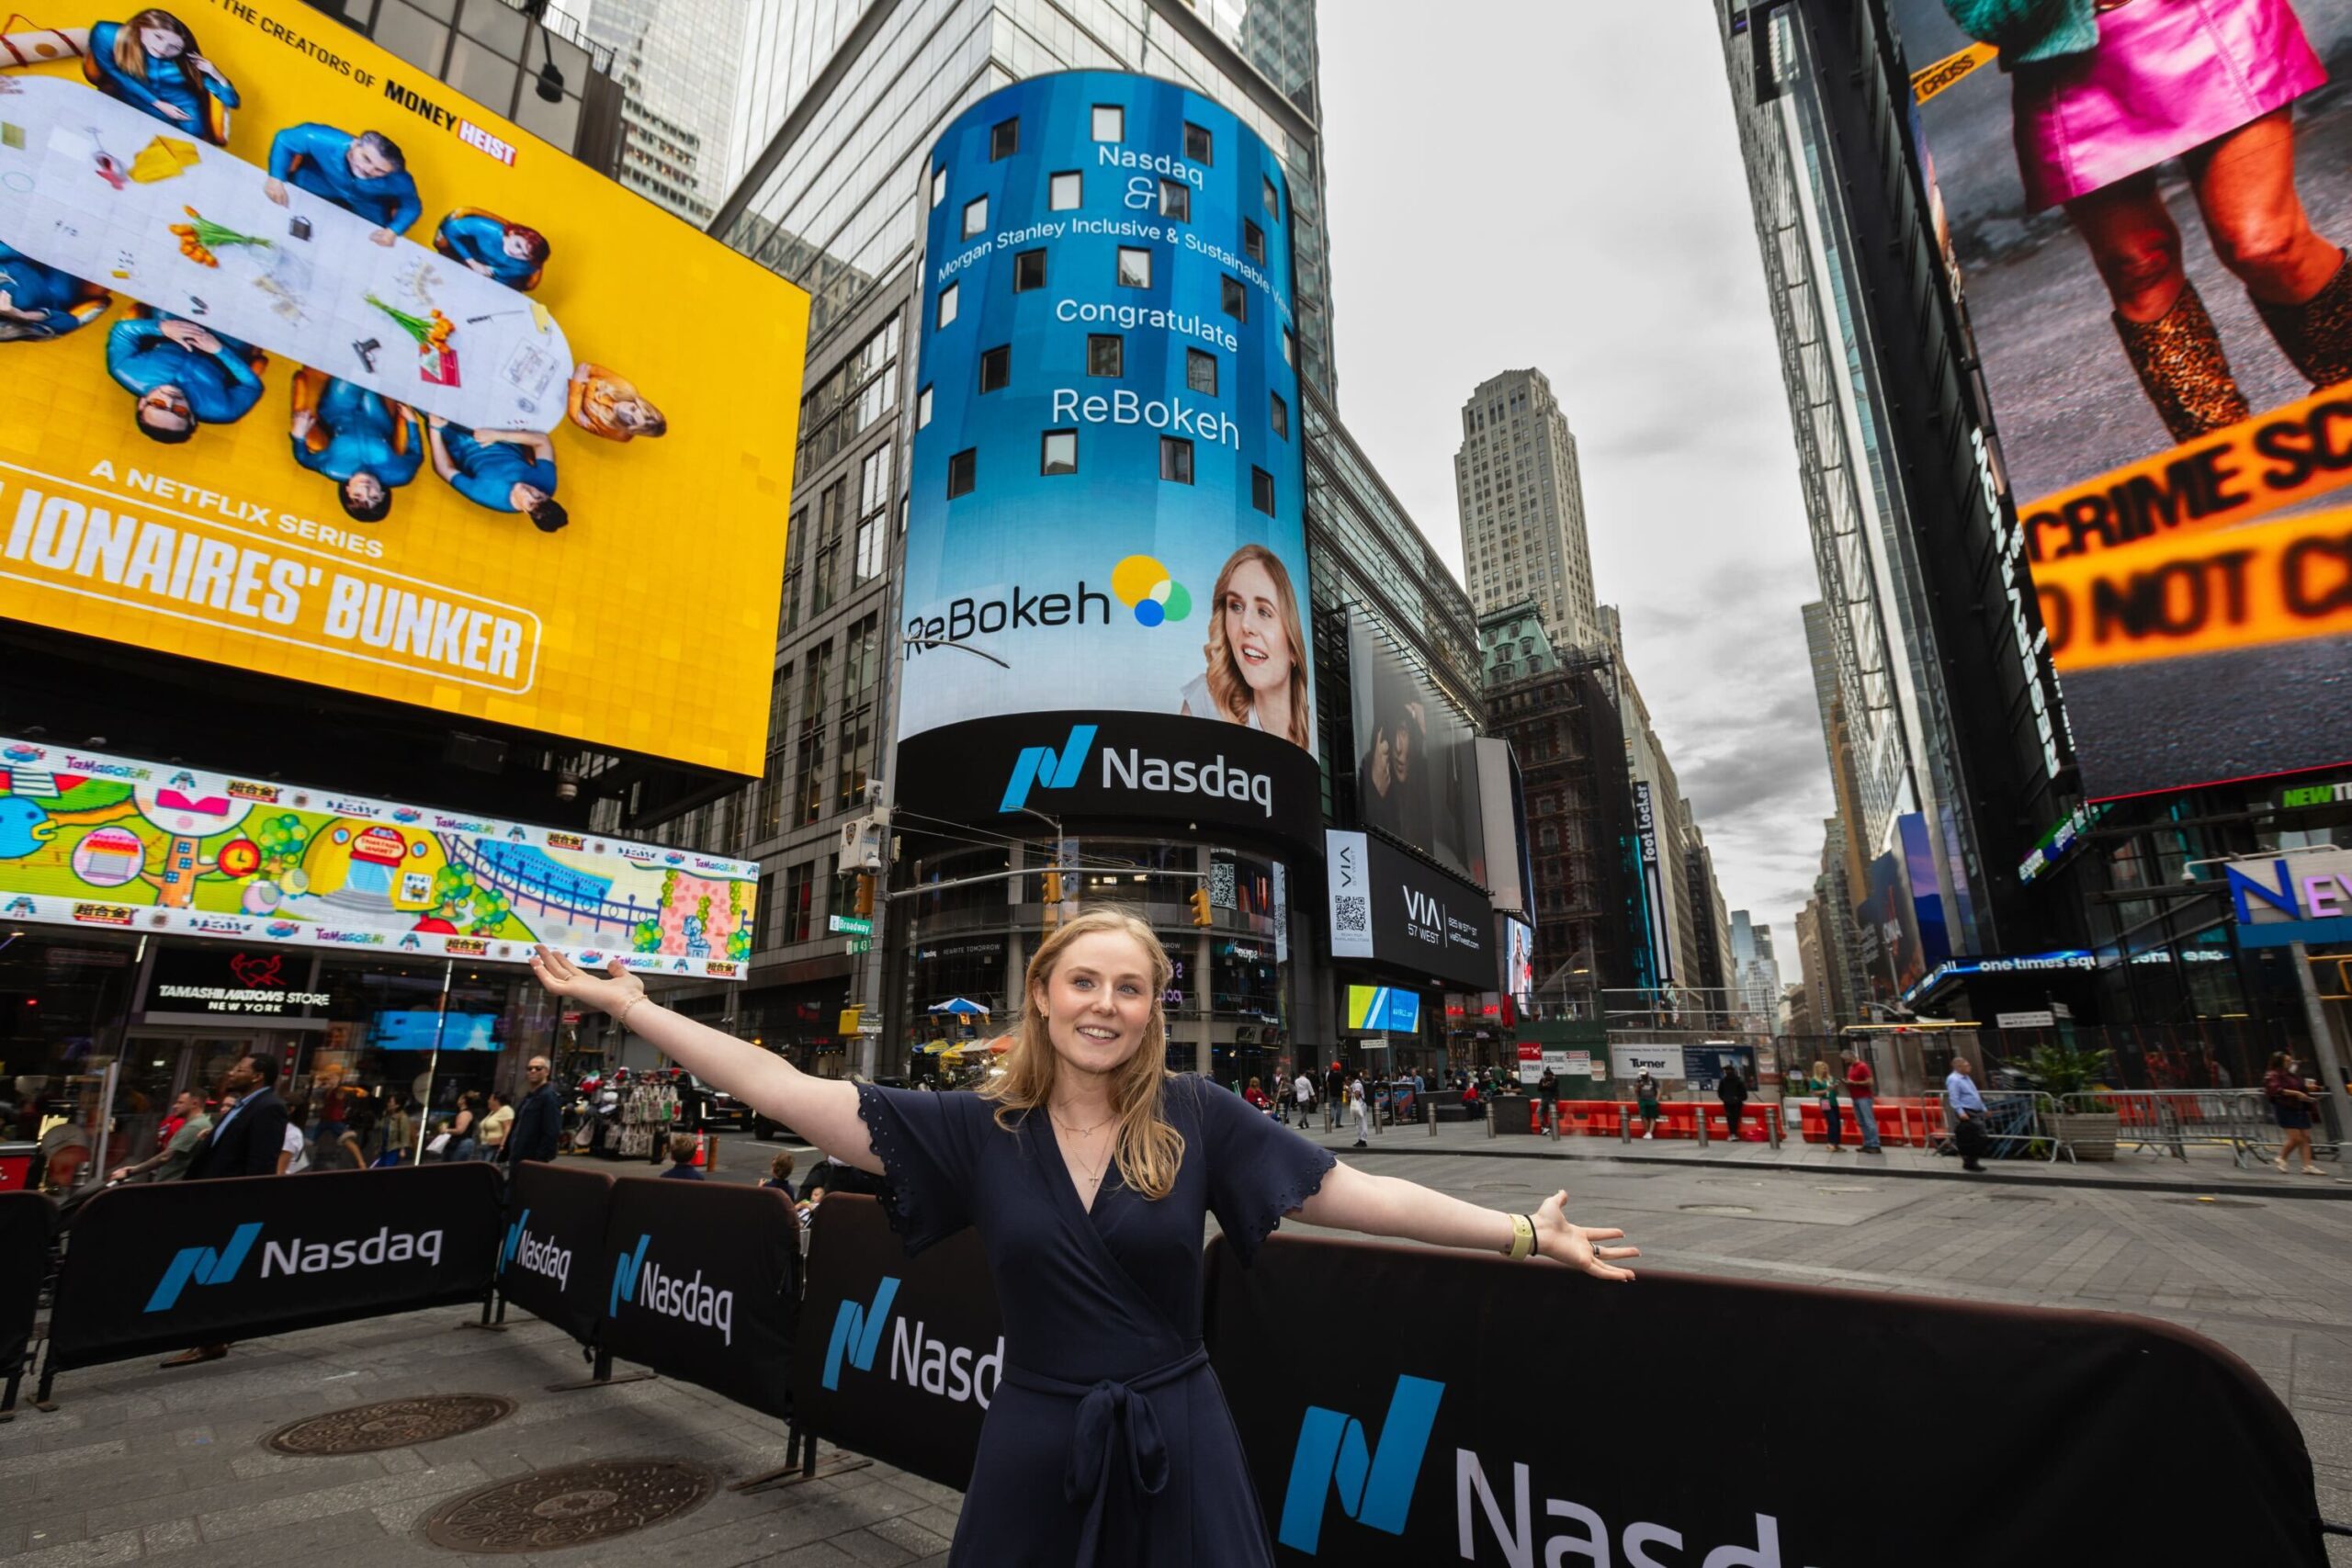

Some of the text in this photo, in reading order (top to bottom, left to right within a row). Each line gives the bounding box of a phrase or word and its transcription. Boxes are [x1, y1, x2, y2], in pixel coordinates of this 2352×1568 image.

[261, 17, 351, 77] CREATORS
[354, 68, 376, 88] OF
[384, 79, 458, 132] MONEY
[458, 119, 516, 165] HEIST
[1921, 54, 1974, 96] CROSS
[1099, 145, 1204, 190] Nasdaq
[1123, 176, 1158, 210] &
[938, 241, 991, 284] Morgan
[997, 221, 1066, 249] Stanley
[1072, 218, 1161, 240] Inclusive
[1167, 227, 1179, 244] &
[1184, 233, 1270, 294] Sustainable
[1056, 299, 1238, 353] Congratulate
[1052, 389, 1240, 450] ReBokeh
[89, 459, 384, 558] A NETFLIX SERIES
[2023, 441, 2251, 562] CRIME
[904, 580, 1111, 660] ReBokeh
[2091, 548, 2260, 646] NOT
[322, 573, 523, 679] BUNKER
[1102, 748, 1273, 818] Nasdaq
[1636, 784, 1657, 862] Foot Locker
[1340, 846, 1351, 887] VIA
[2223, 859, 2352, 925] NE
[838, 919, 870, 935] Broadway
[1403, 885, 1442, 931] VIA
[1408, 923, 1440, 945] 57 WEST
[853, 940, 867, 953] W 43
[967, 943, 1001, 953] TOMORROW
[1979, 961, 2012, 972] one
[2013, 957, 2065, 970] times
[159, 985, 331, 1006] TAMASHII NATIONS STORE
[208, 1001, 283, 1013] NEW YORK
[1629, 1057, 1666, 1069] Turner
[260, 1225, 443, 1279] Nasdaq
[517, 1229, 571, 1292] Nasdaq
[640, 1261, 732, 1347] Nasdaq
